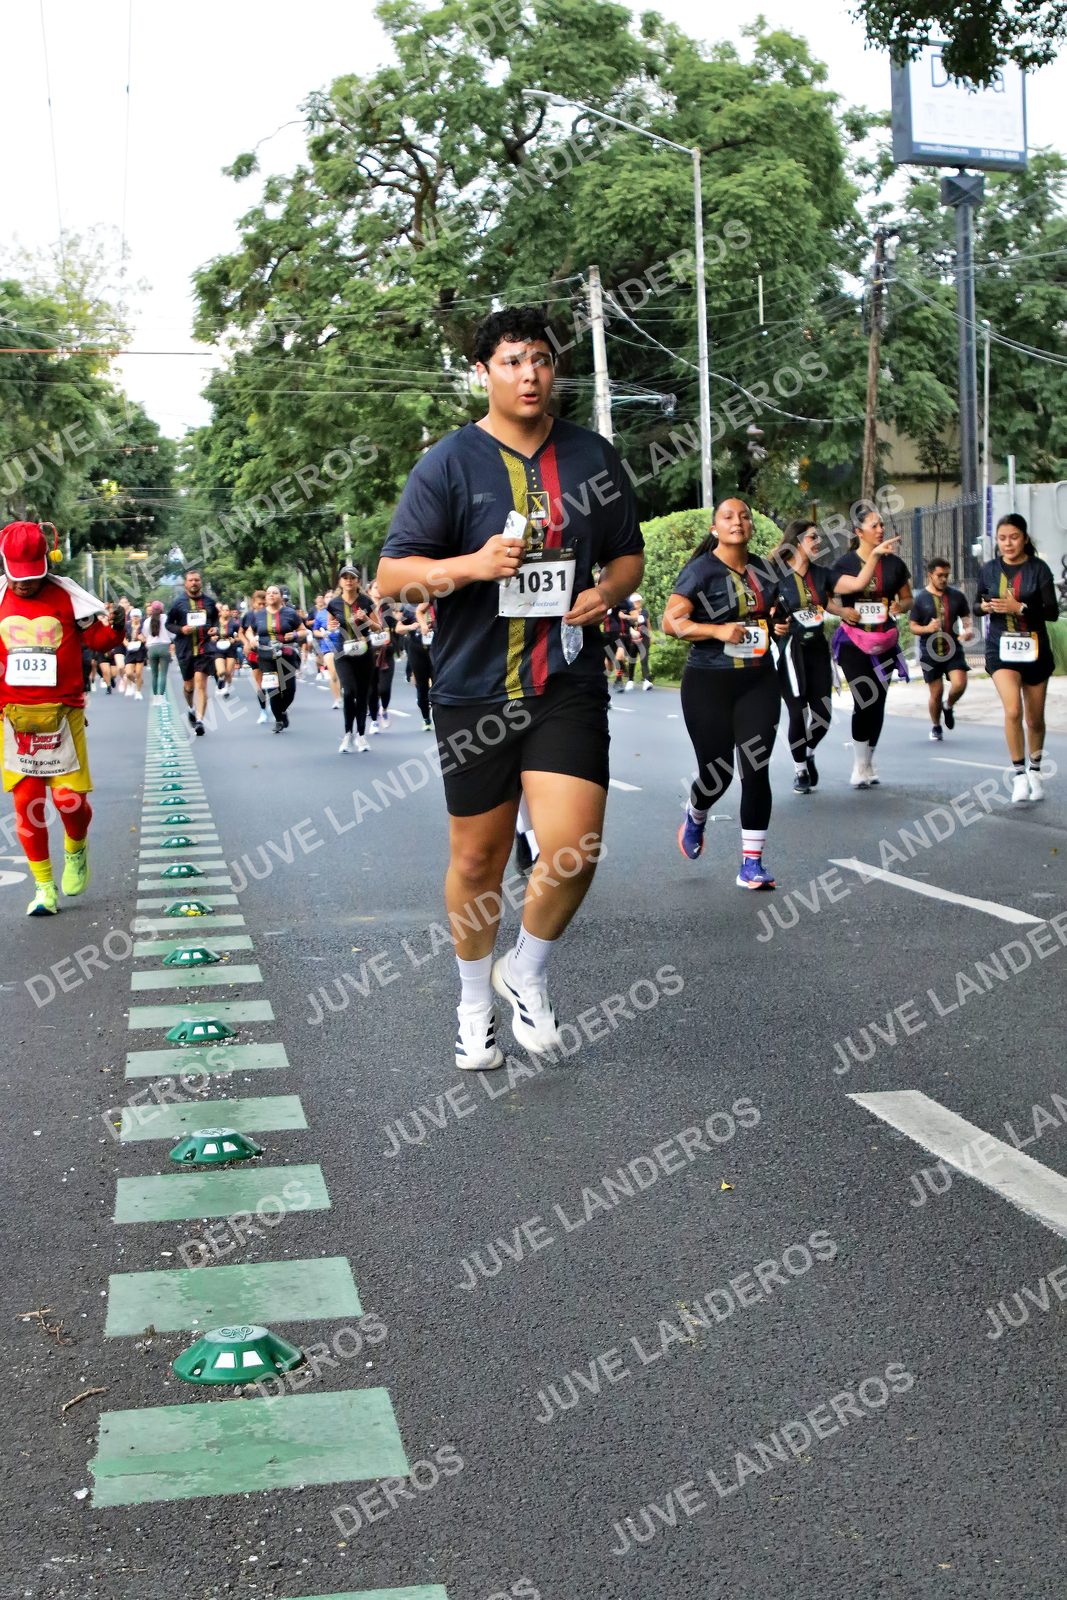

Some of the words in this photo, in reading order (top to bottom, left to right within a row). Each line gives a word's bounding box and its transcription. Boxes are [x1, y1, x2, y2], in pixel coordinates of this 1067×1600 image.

[516, 570, 566, 594] 1031
[860, 605, 881, 614] 6303
[1006, 641, 1030, 650] 1429
[15, 658, 47, 671] 1033
